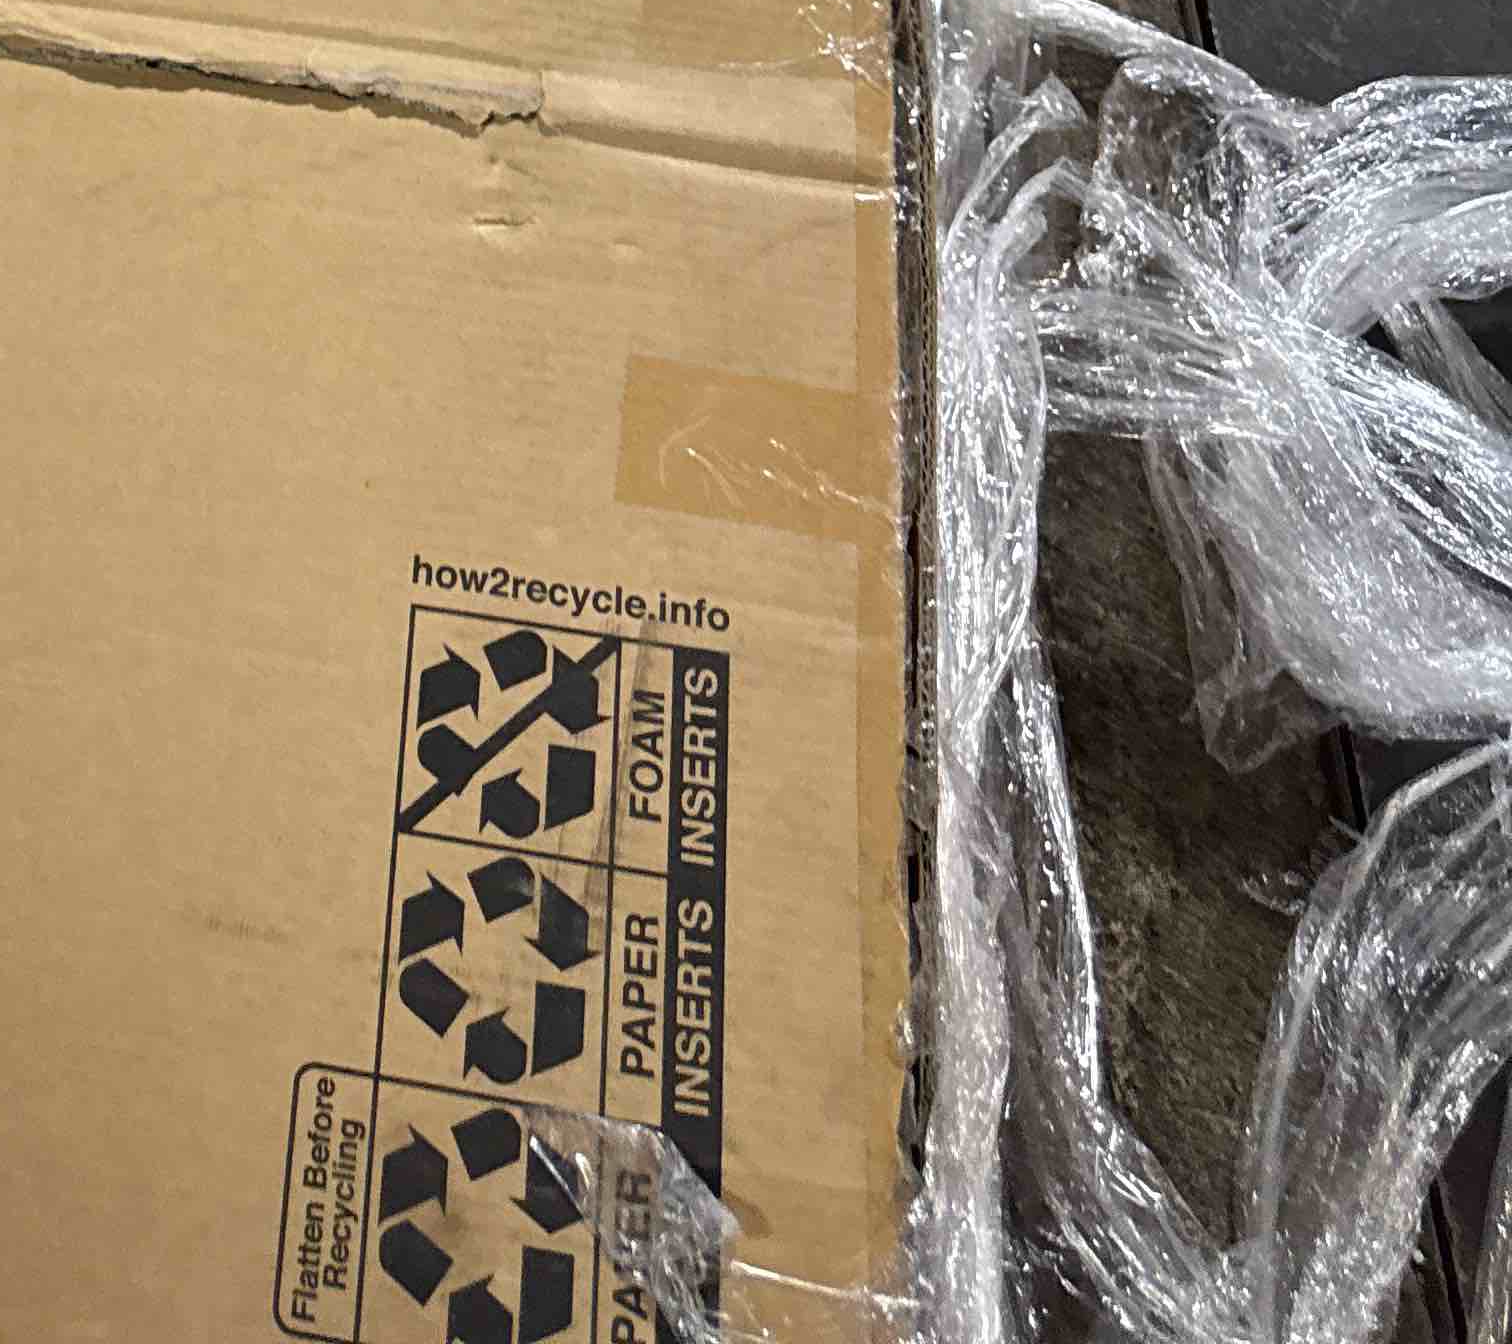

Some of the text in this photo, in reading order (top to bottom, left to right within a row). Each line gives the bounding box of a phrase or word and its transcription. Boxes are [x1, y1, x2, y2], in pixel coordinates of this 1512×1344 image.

[410, 553, 730, 634] how2recycle.info
[628, 689, 665, 823] FOAM
[681, 666, 719, 868] INSERTS
[620, 912, 659, 1080] PAPER
[674, 897, 715, 1118] INSERTS
[291, 1076, 336, 1324] Flatten Before
[322, 1117, 366, 1292] Recycling
